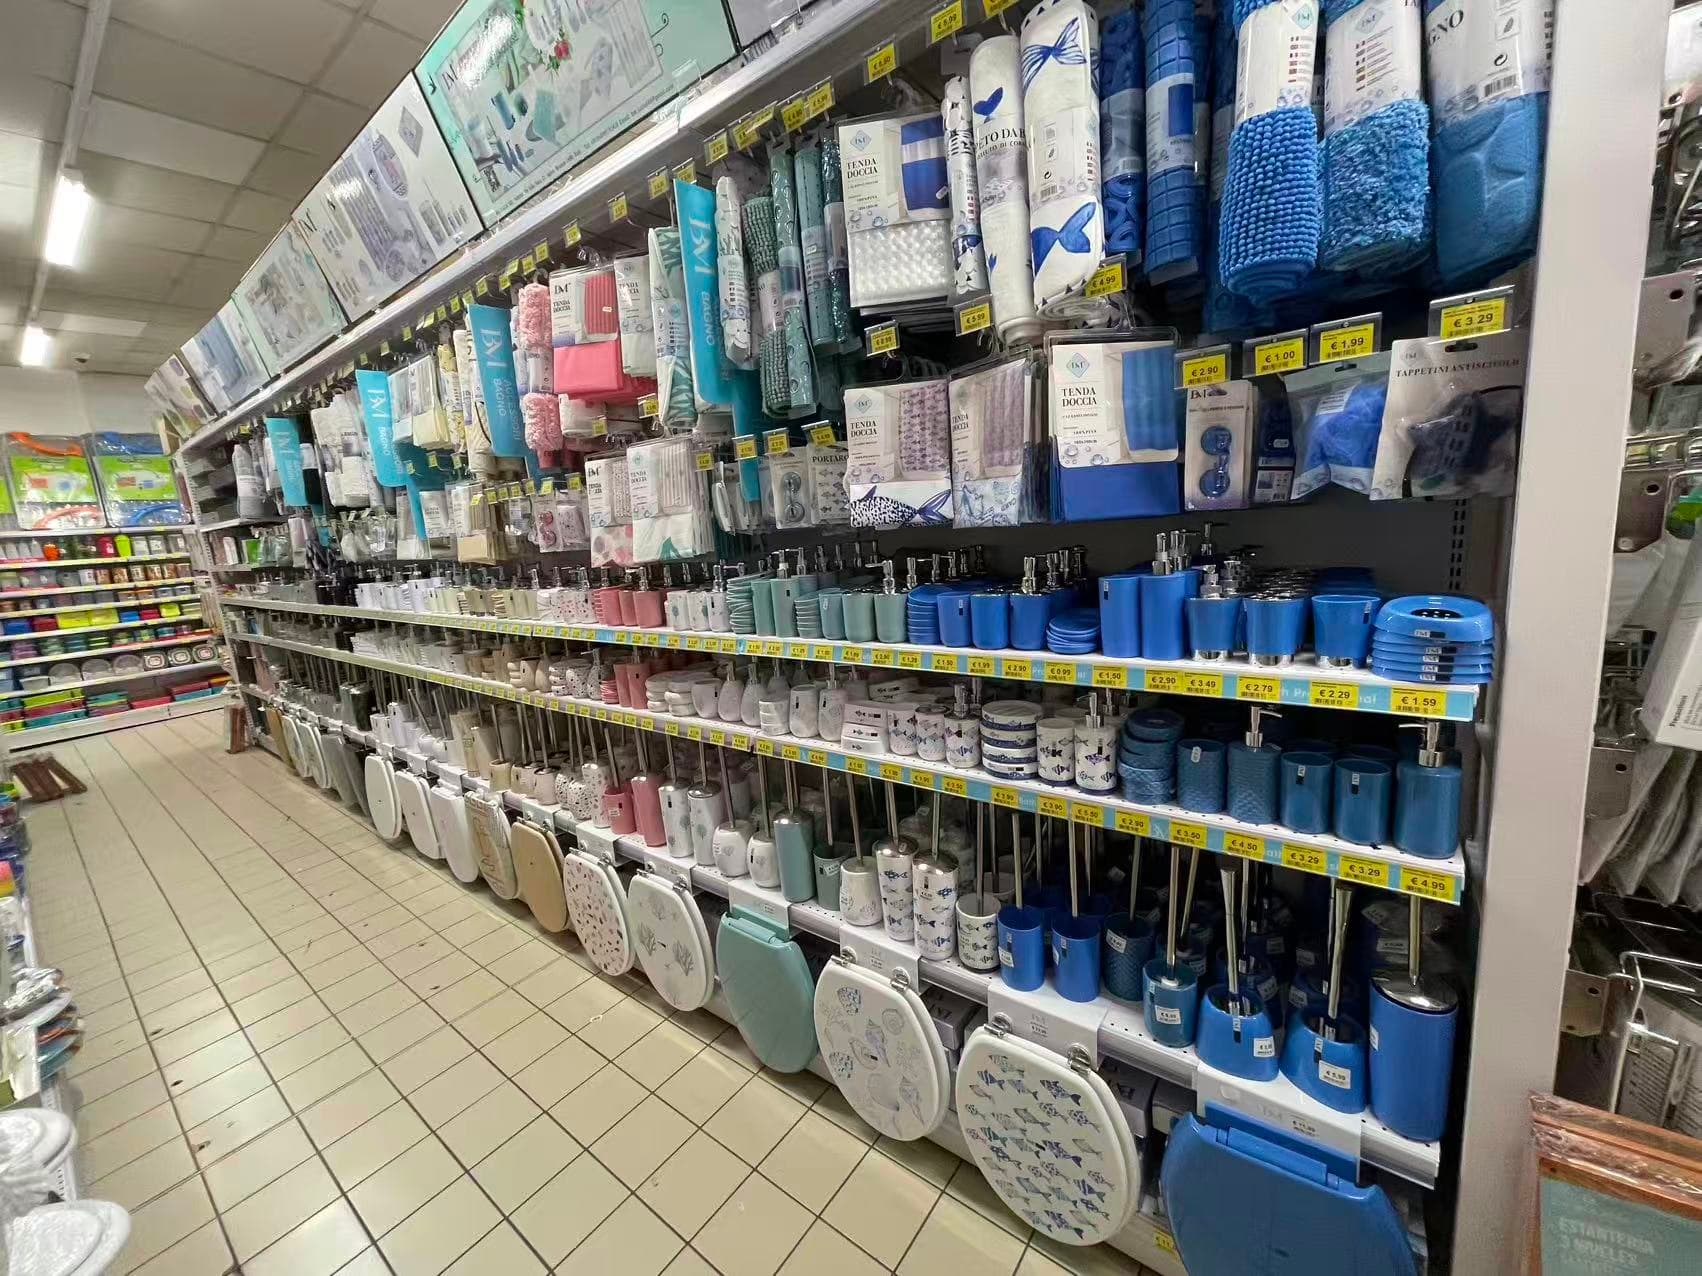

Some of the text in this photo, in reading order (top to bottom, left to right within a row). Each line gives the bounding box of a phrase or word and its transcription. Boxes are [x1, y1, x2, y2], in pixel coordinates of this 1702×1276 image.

[847, 166, 878, 179] DOCCIA
[701, 290, 715, 346] BAGNO
[1454, 319, 1462, 329] €
[1331, 338, 1364, 350] € 1.99
[1192, 369, 1197, 377] €
[1396, 367, 1449, 377] TAPPETINI
[1061, 387, 1096, 397] TENDA
[494, 378, 507, 417] BAGNO
[1062, 397, 1097, 407] DOCCIA
[850, 420, 877, 429] TENDA
[850, 428, 877, 438] DOCCIA
[1158, 676, 1176, 685] 2.90
[1319, 689, 1326, 697] €
[1402, 697, 1409, 705] €
[1349, 864, 1355, 872] €
[1411, 877, 1445, 890] € 4.99
